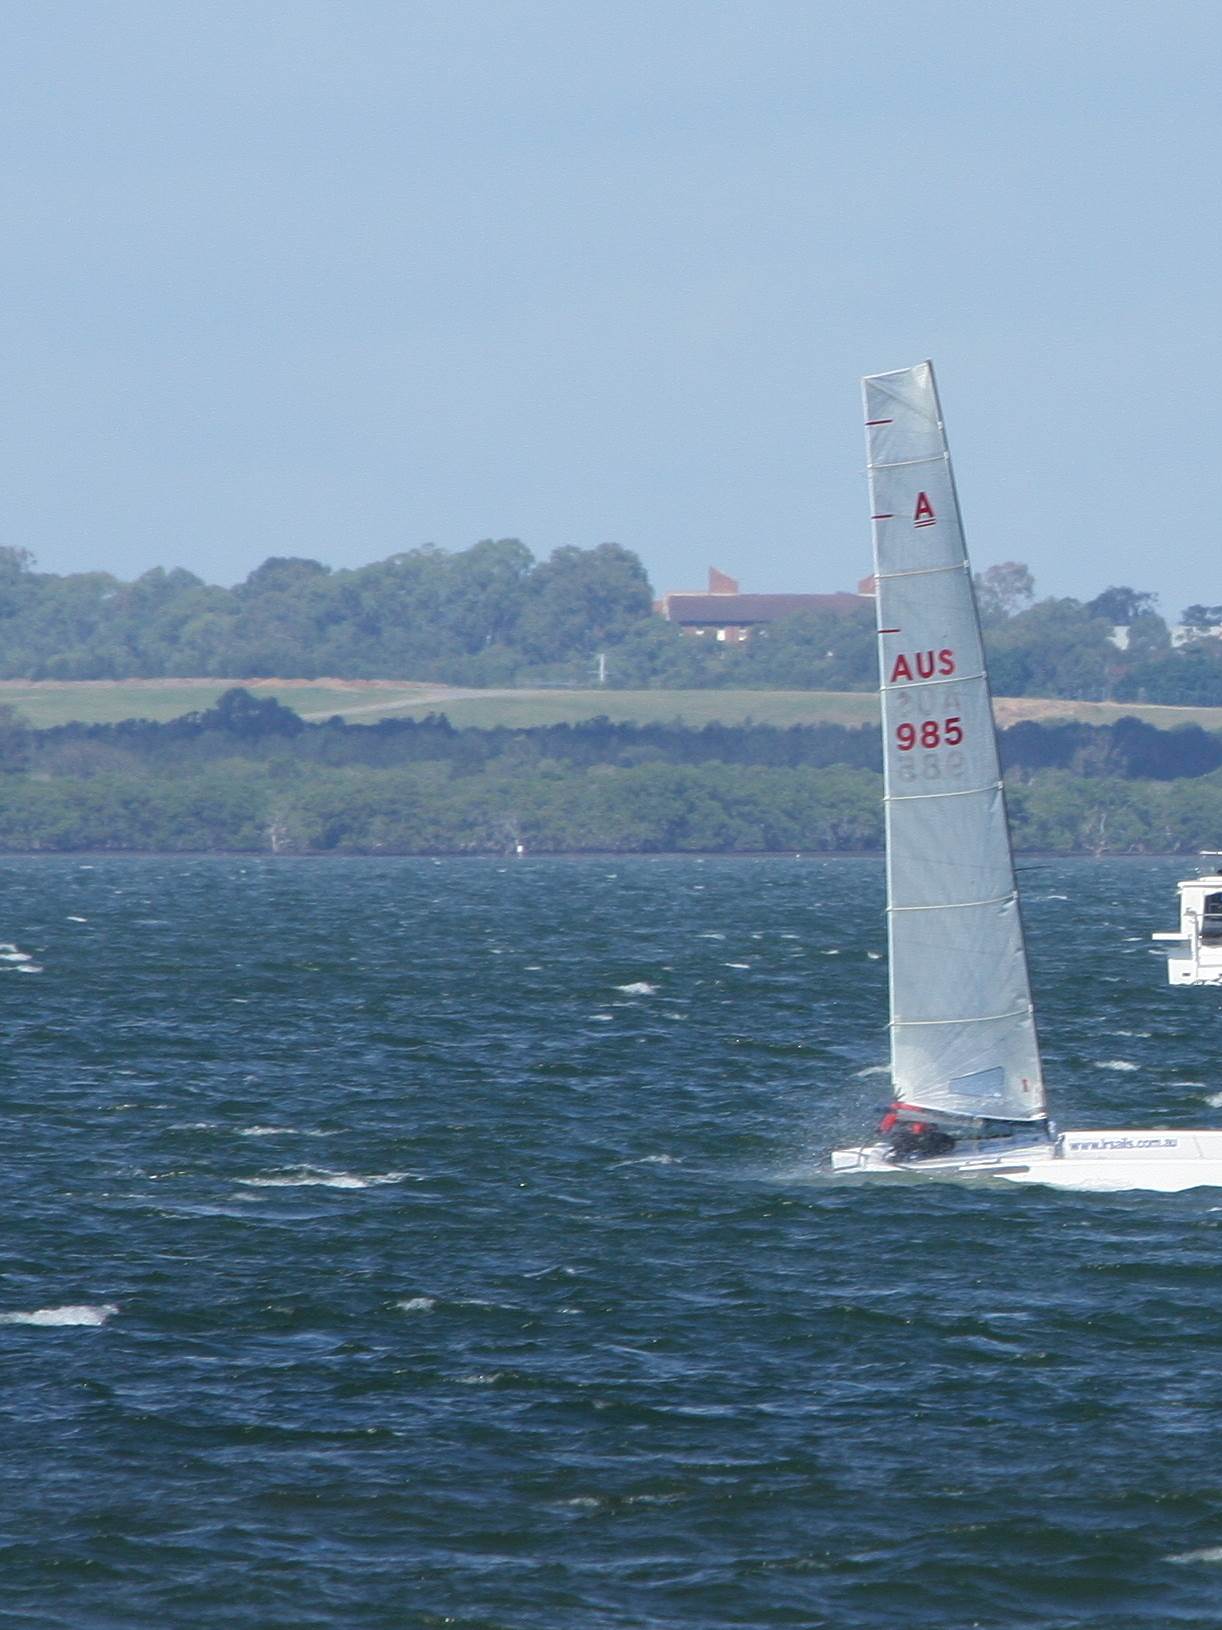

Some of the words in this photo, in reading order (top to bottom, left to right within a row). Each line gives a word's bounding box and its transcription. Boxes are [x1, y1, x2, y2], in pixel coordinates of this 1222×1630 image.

[914, 491, 936, 520] A
[890, 648, 956, 683] AUS
[896, 717, 963, 751] 985
